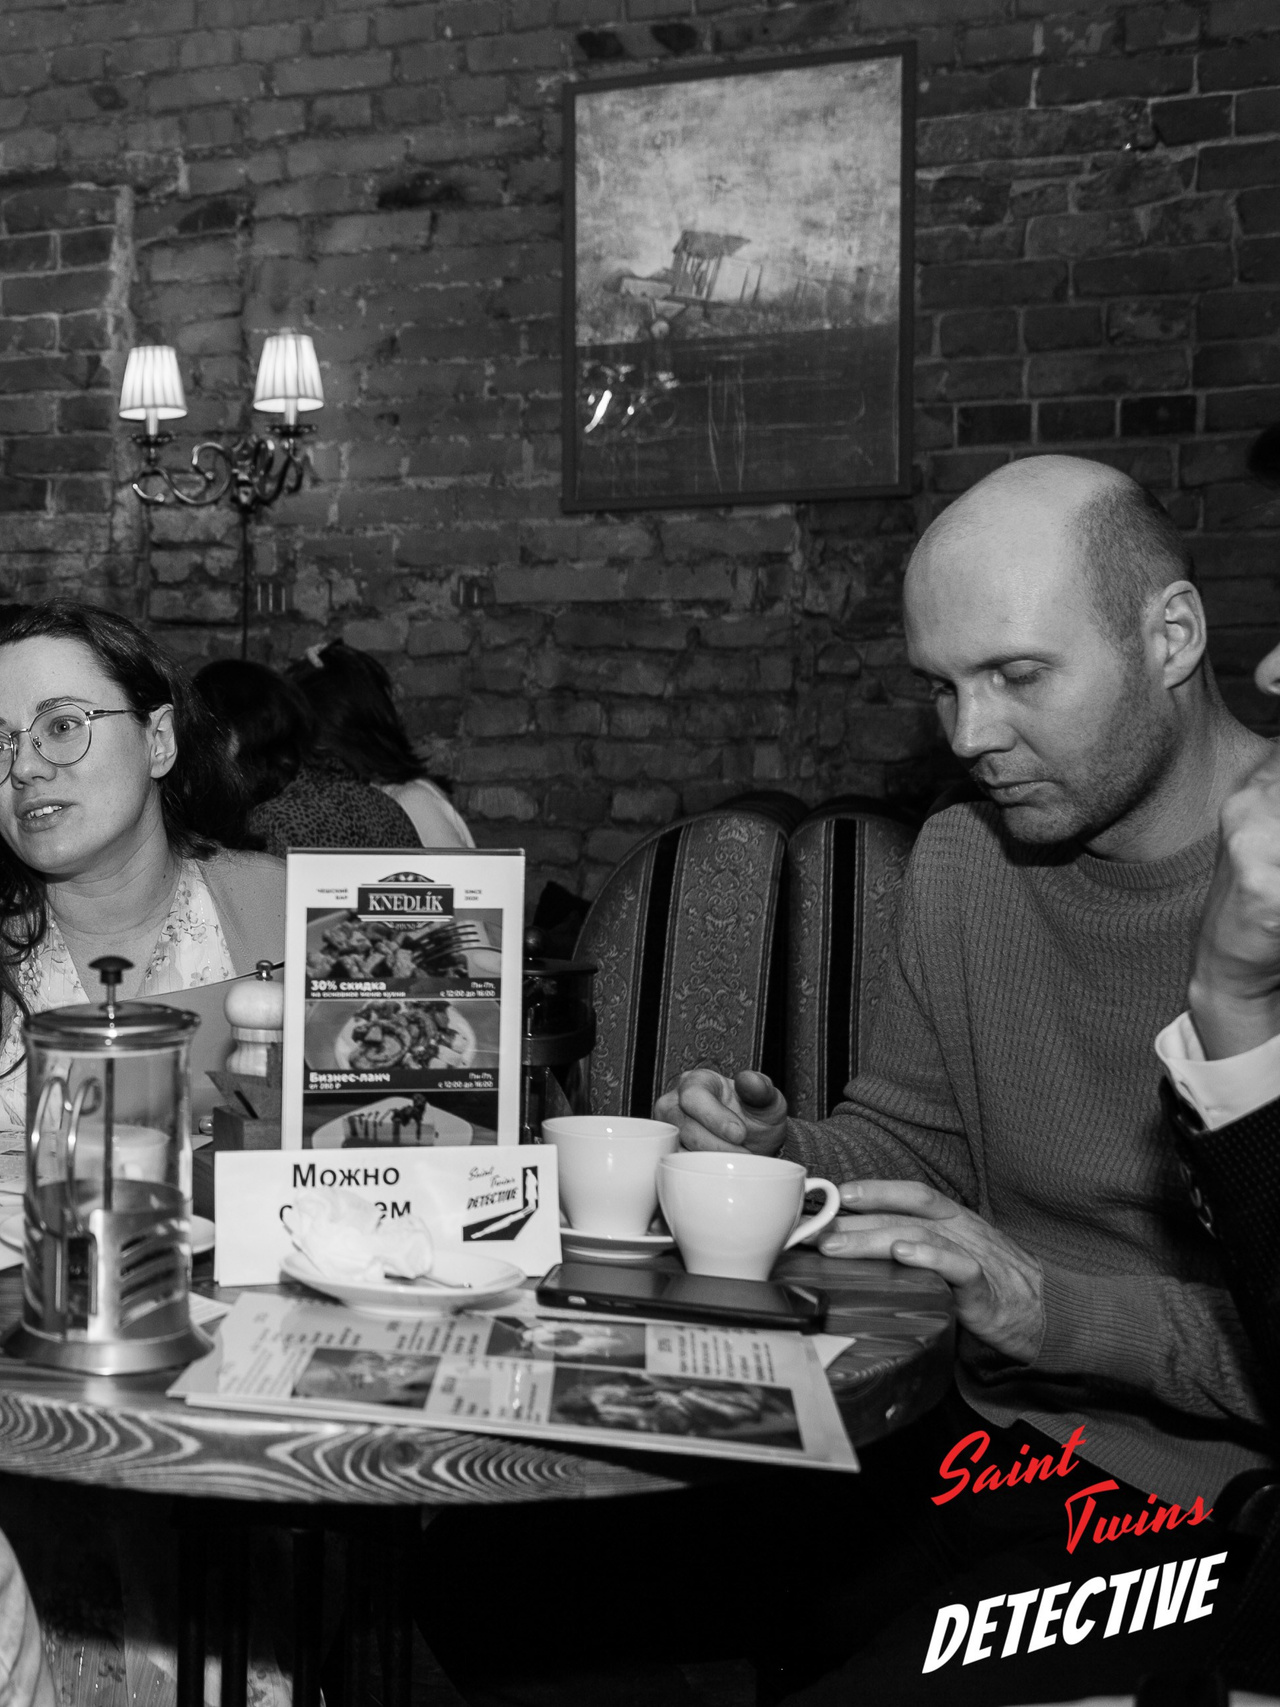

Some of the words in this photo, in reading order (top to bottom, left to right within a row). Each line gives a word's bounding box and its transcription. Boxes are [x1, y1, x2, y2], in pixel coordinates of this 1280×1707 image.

[310, 980, 338, 991] 30%
[339, 981, 387, 992] скидка
[309, 1072, 391, 1083] Бизнес-ланч
[292, 1163, 400, 1188] Можно
[467, 1187, 519, 1210] DETECTIVE
